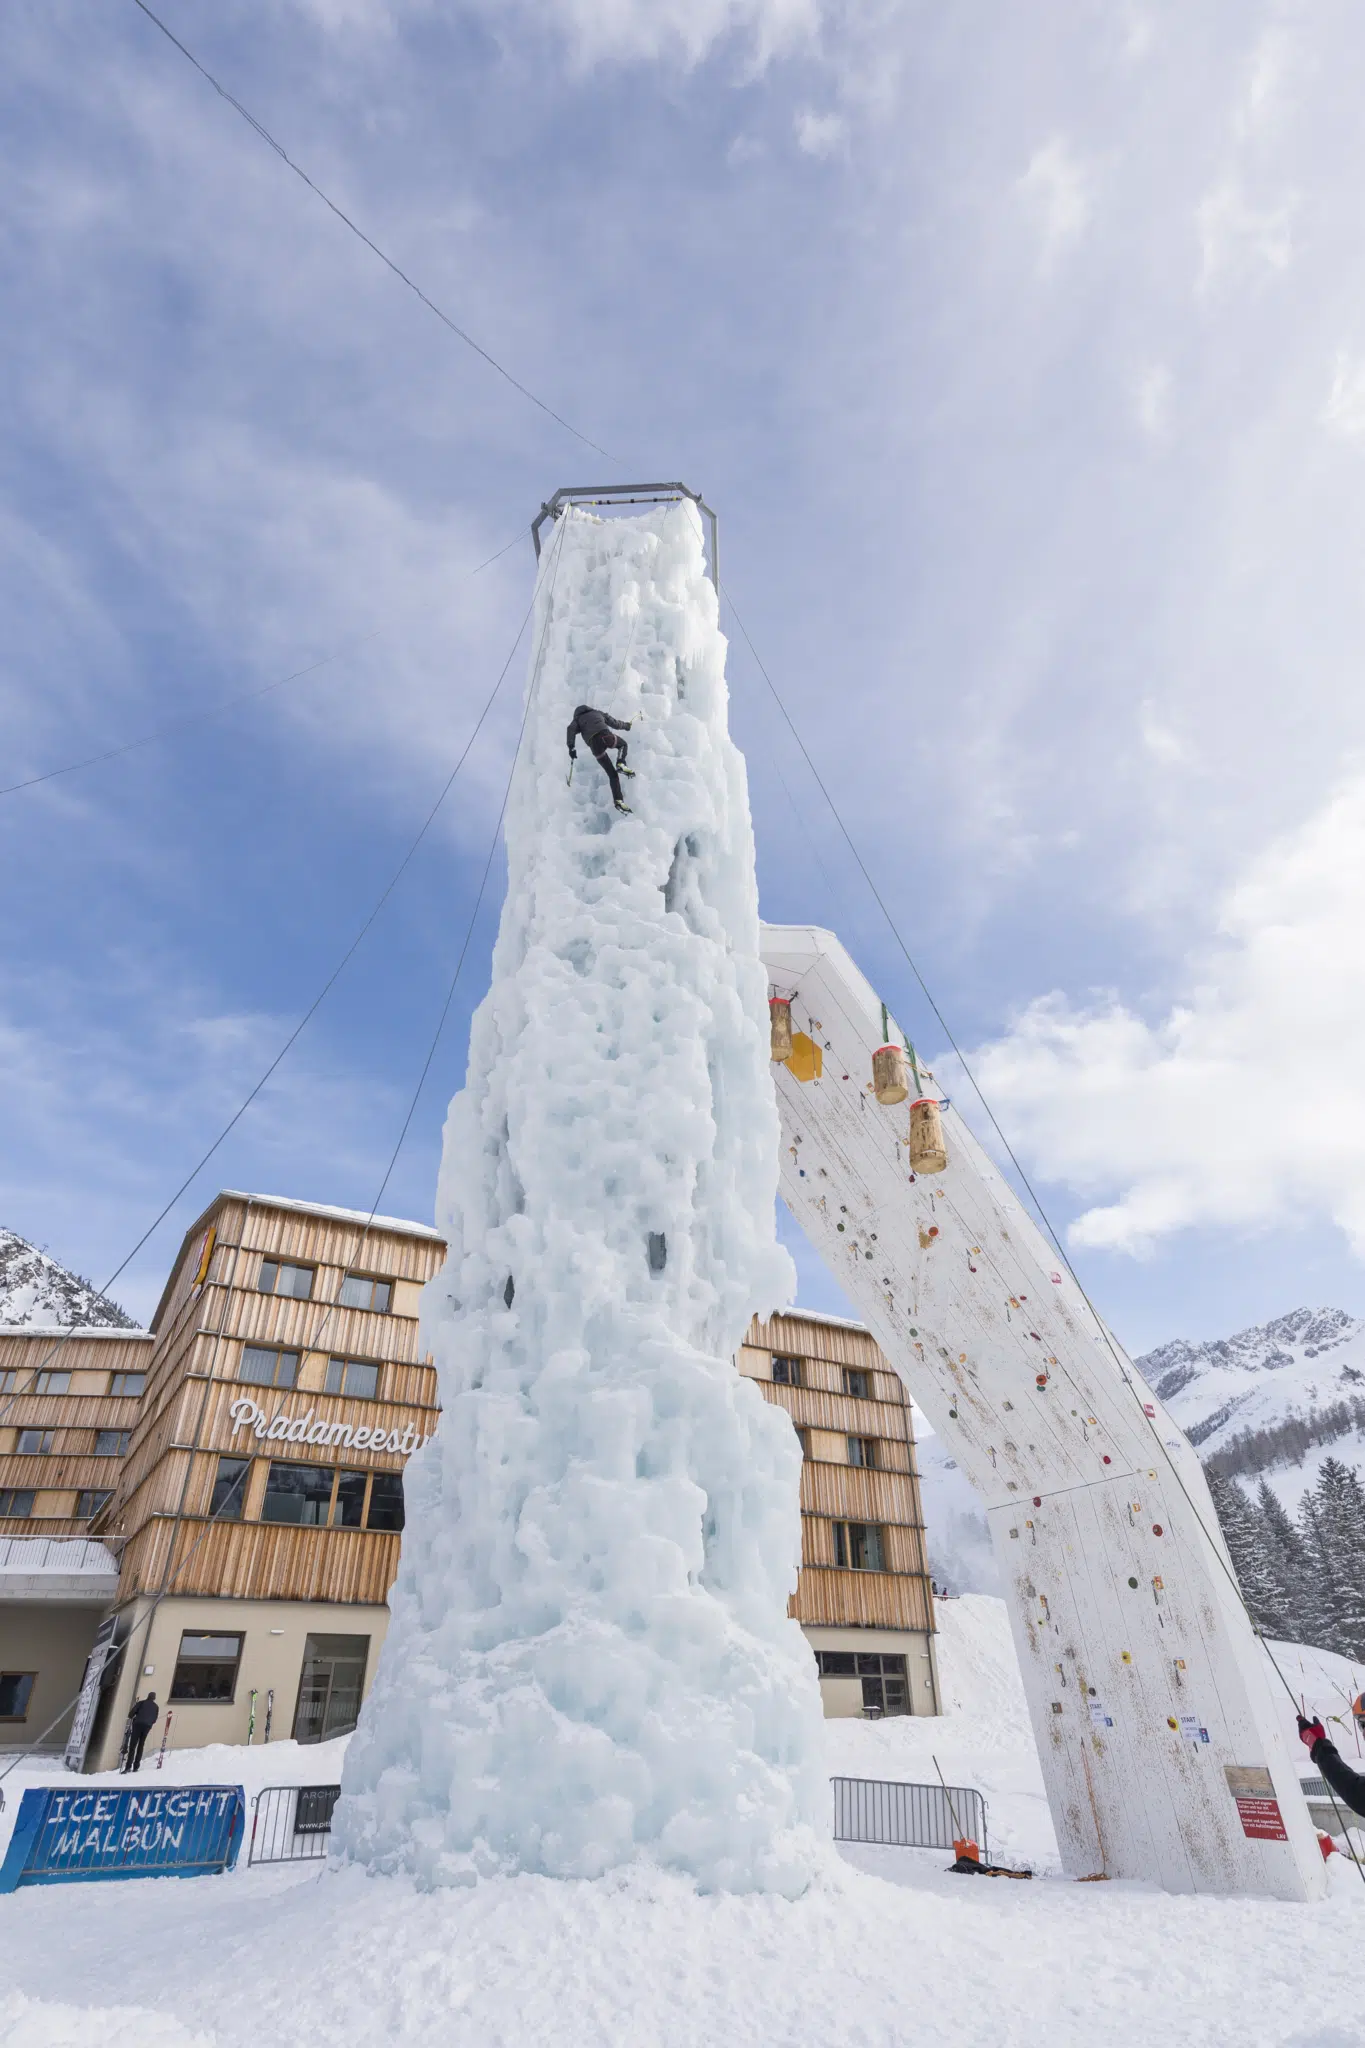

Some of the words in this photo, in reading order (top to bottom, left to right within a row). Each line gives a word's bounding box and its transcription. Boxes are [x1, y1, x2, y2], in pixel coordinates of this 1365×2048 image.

[48, 1794, 119, 1824] ICE
[128, 1790, 235, 1821] NIGHT
[51, 1821, 184, 1857] MALBUN
